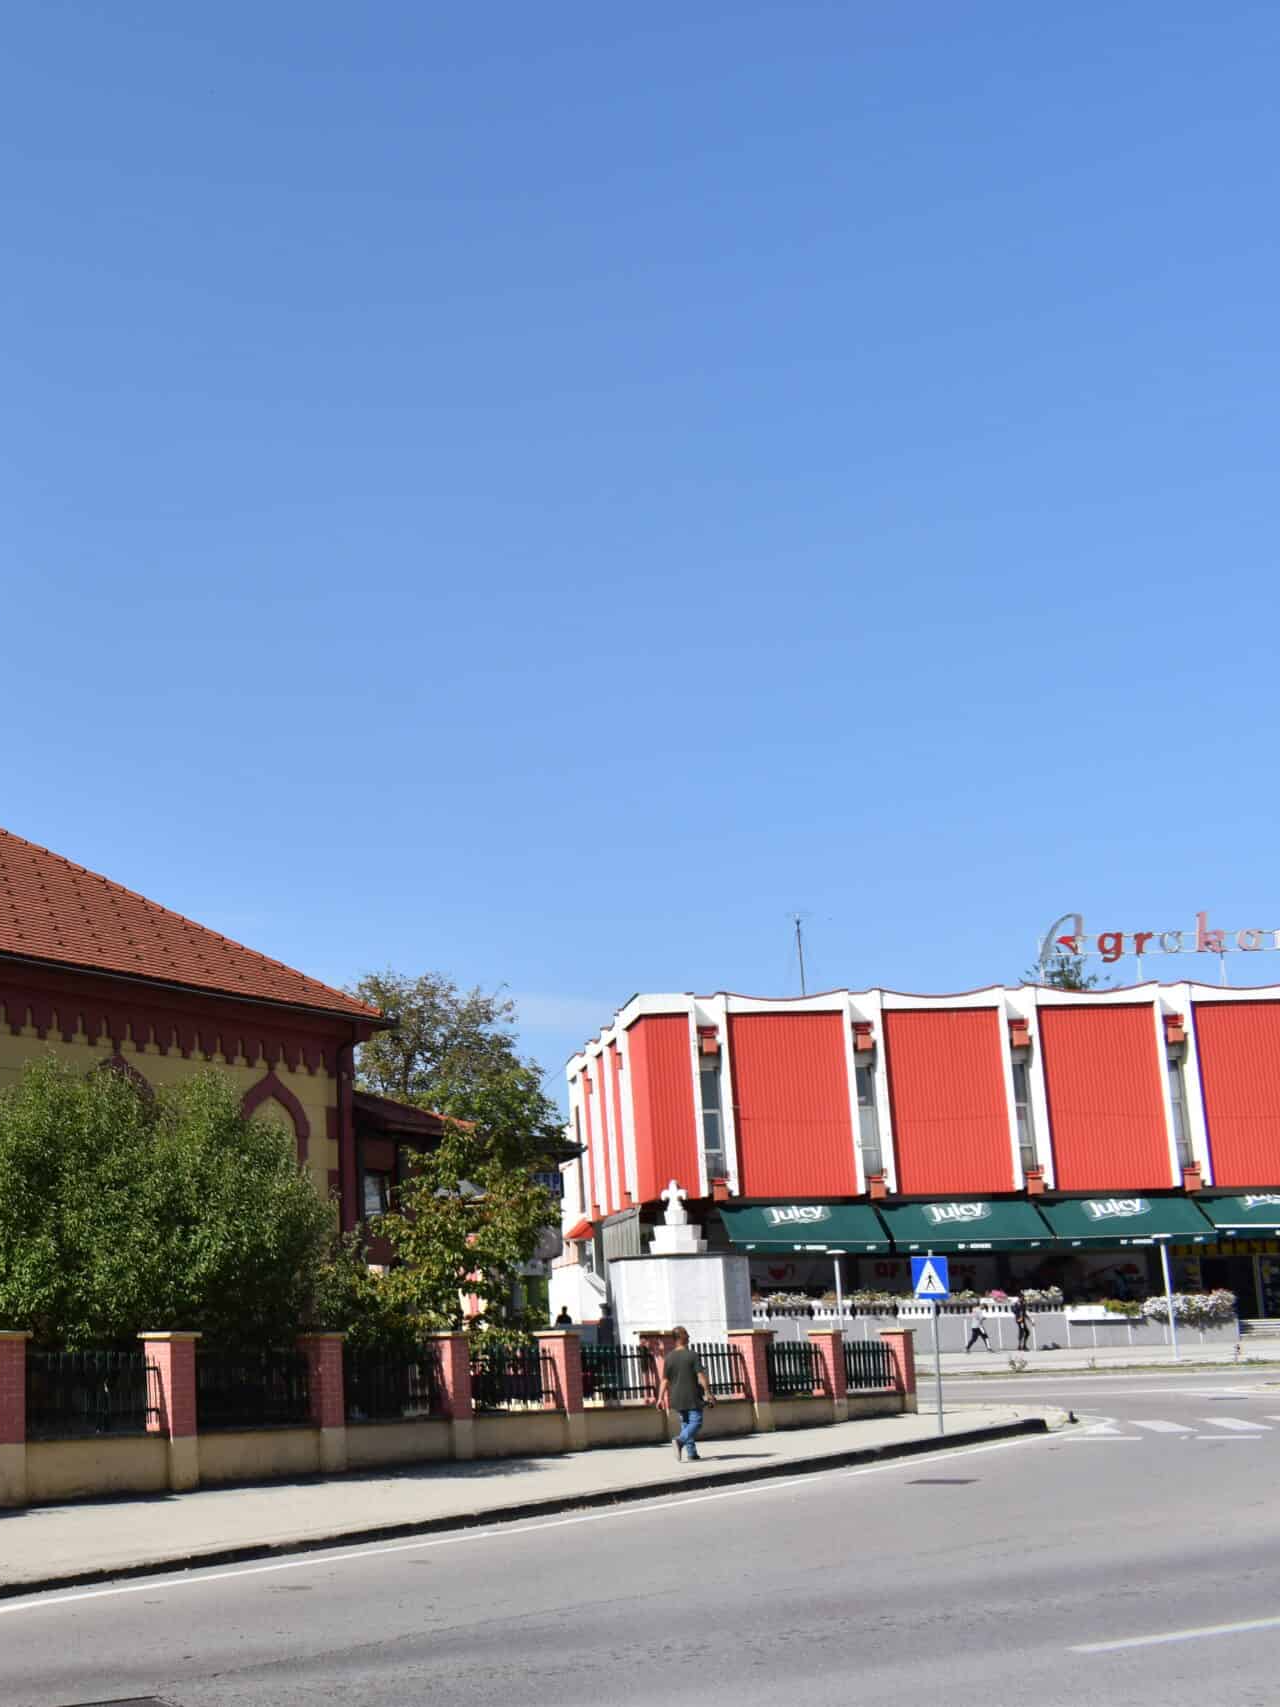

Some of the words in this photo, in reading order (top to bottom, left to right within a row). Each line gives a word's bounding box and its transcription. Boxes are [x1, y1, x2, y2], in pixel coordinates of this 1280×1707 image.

[1039, 911, 1280, 966] Agroko
[770, 1205, 824, 1224] Juicy
[930, 1202, 984, 1222] Juicy
[1089, 1199, 1142, 1218] Juicy
